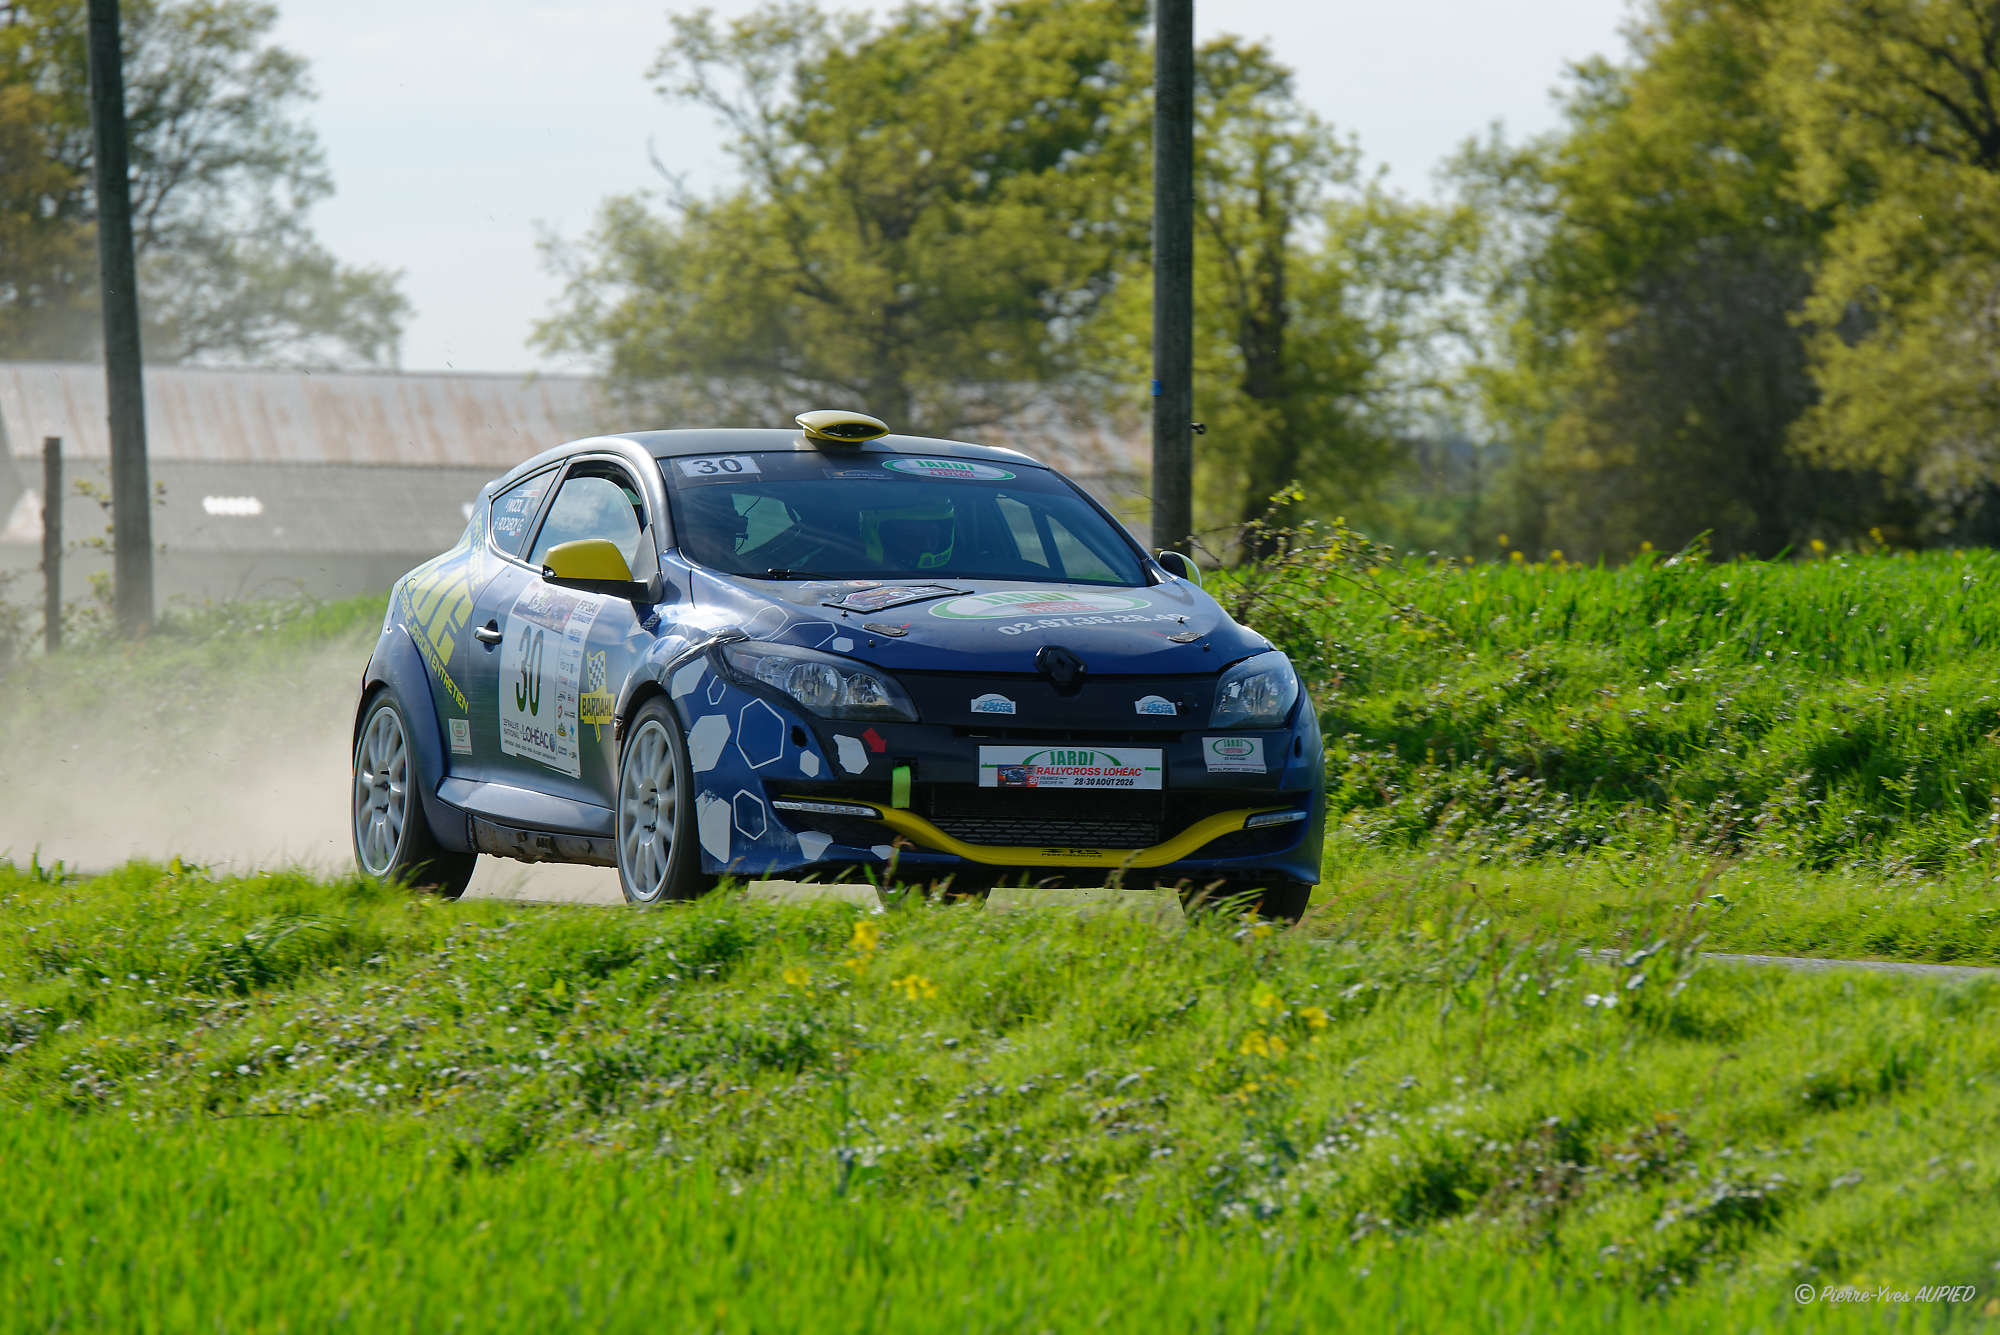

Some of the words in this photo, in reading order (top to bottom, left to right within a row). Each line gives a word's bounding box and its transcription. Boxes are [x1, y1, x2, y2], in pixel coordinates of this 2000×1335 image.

[693, 458, 743, 474] 30
[515, 625, 545, 717] 30
[431, 654, 470, 714] ENTRETIEN
[582, 697, 613, 717] BARDAHL
[522, 724, 549, 750] LOHÉAC
[1050, 750, 1095, 766] JARDI
[1036, 767, 1101, 776] RALLYCROSS
[1103, 766, 1143, 777] LOHÉAC
[1096, 777, 1116, 787] AOÛT
[1115, 778, 1134, 787] 2026
